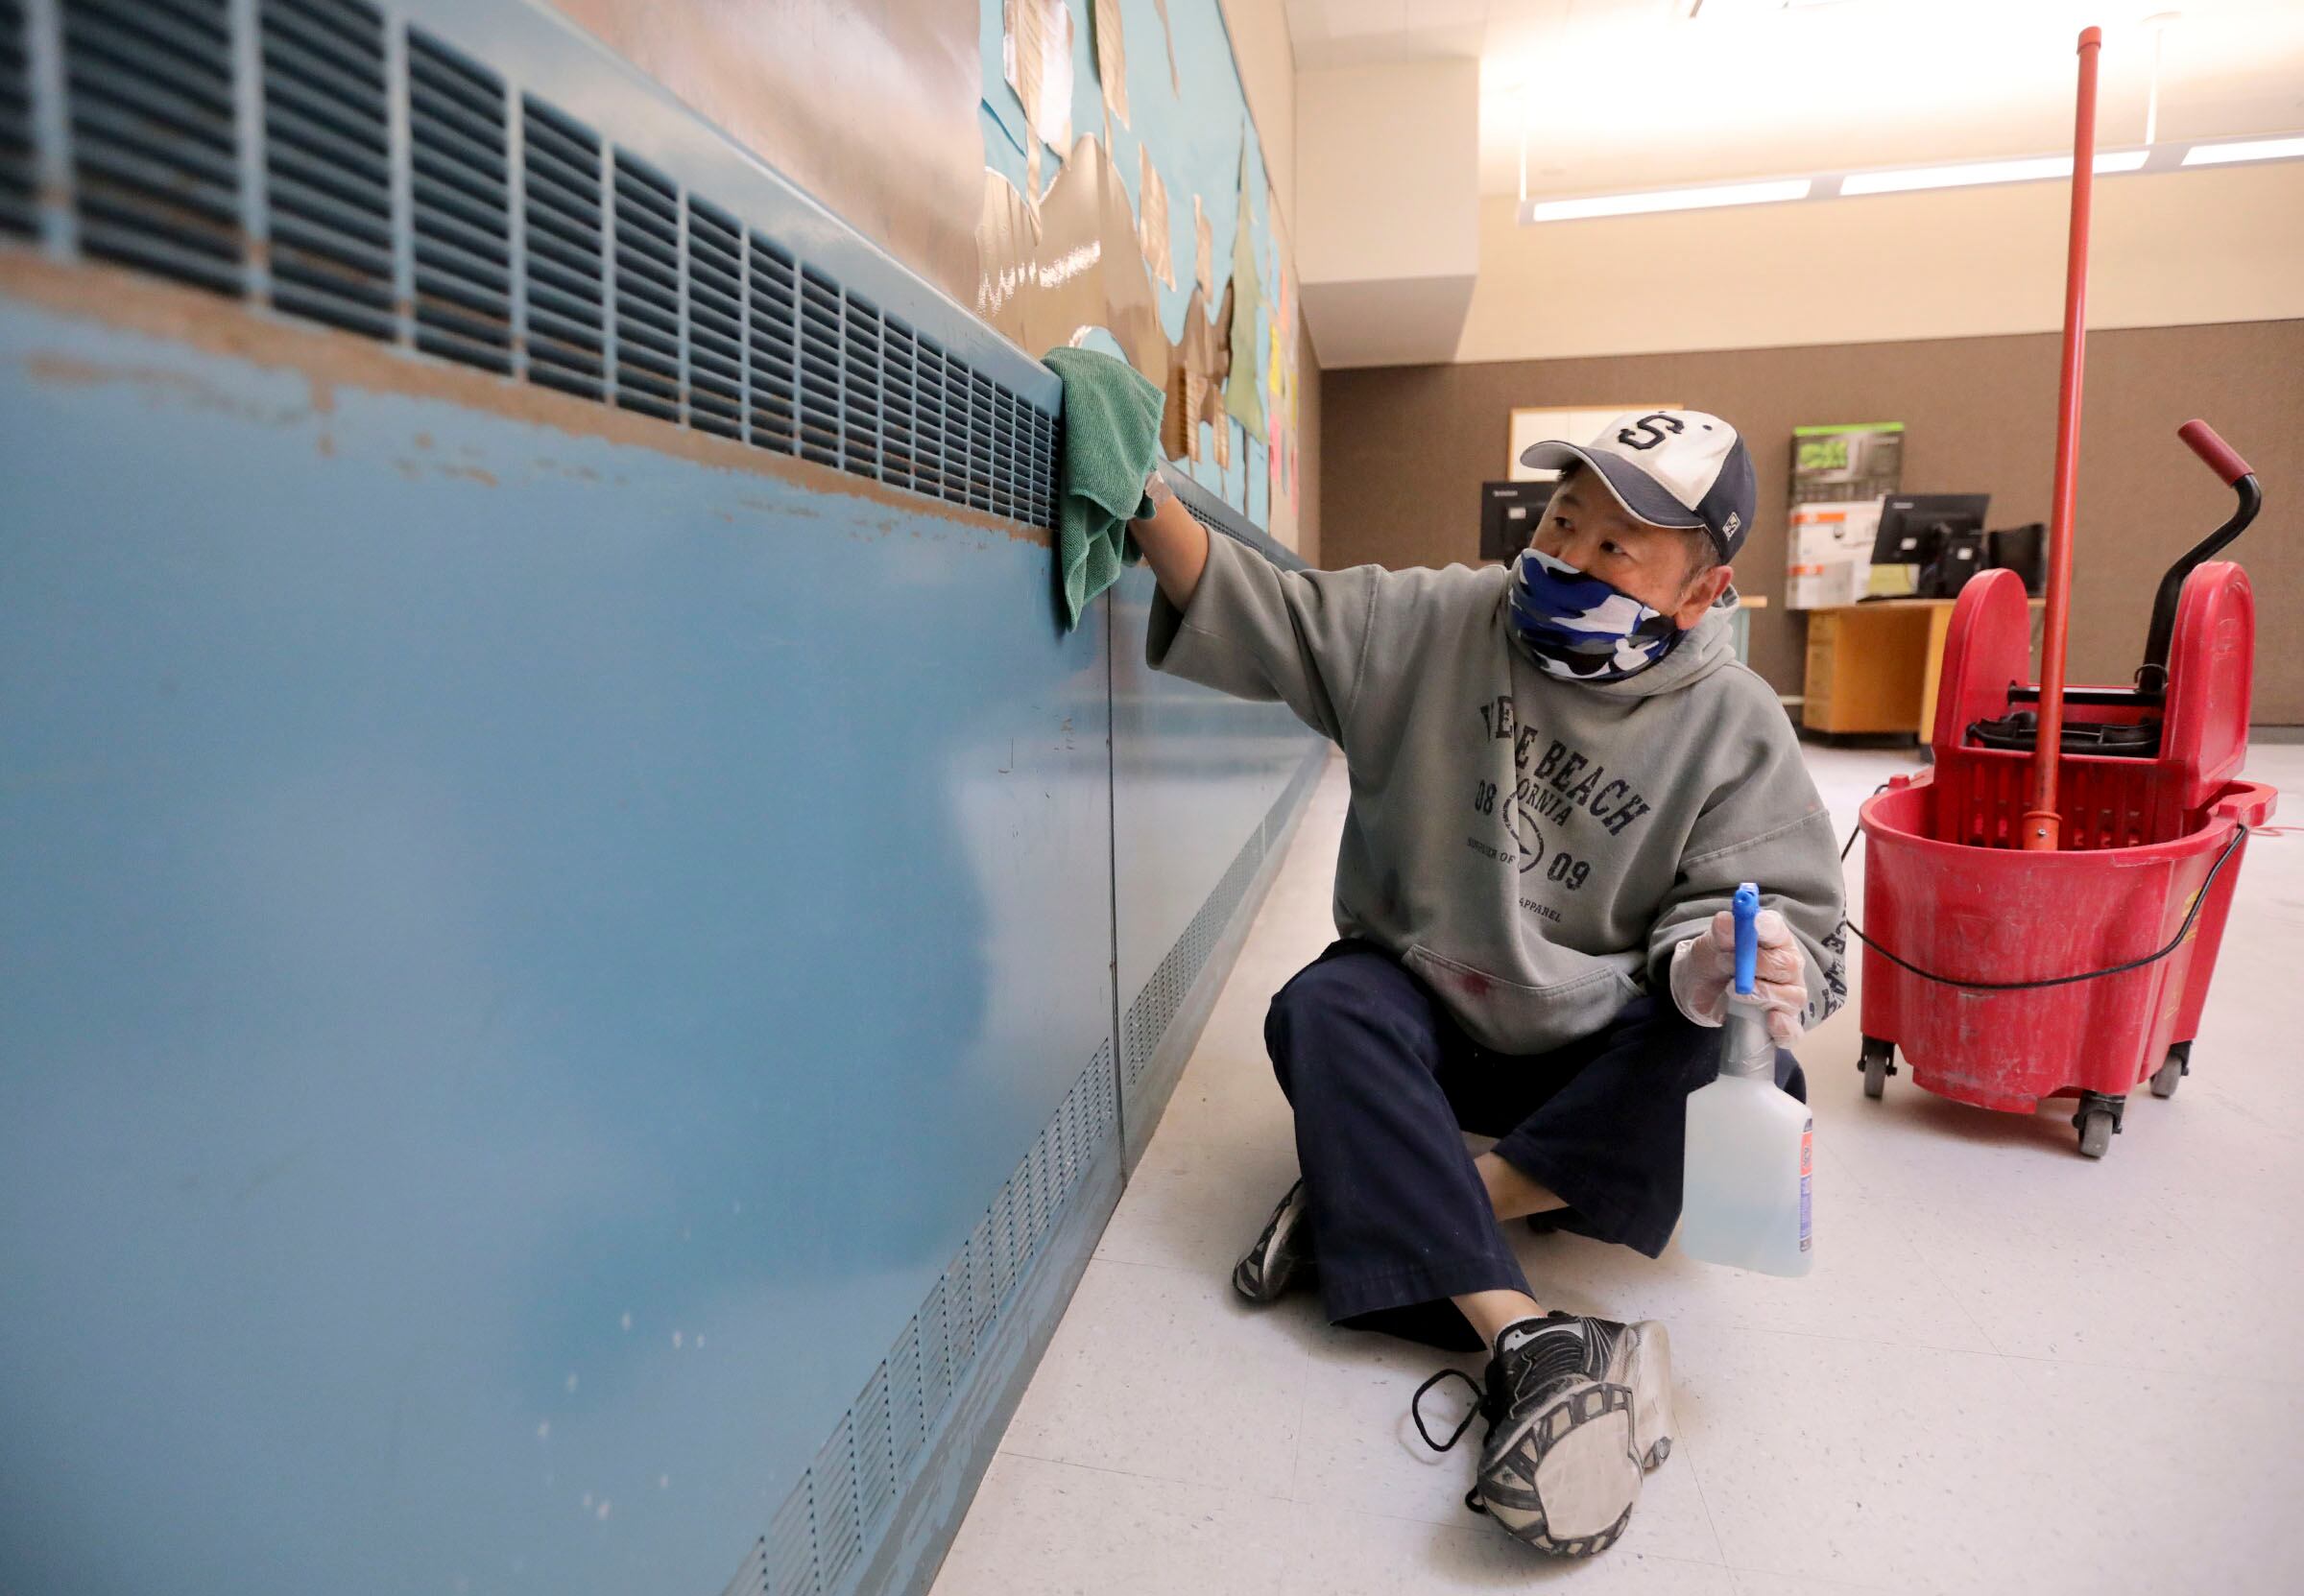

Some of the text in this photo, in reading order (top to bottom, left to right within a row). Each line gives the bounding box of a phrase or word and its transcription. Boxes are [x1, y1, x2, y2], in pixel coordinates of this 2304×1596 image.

[1619, 414, 1685, 450] S
[1475, 779, 1498, 816] 08
[1517, 774, 1572, 827] ORNIA
[1534, 739, 1650, 836] BEACH
[1500, 852, 1516, 865] OF
[1547, 852, 1591, 891] 09
